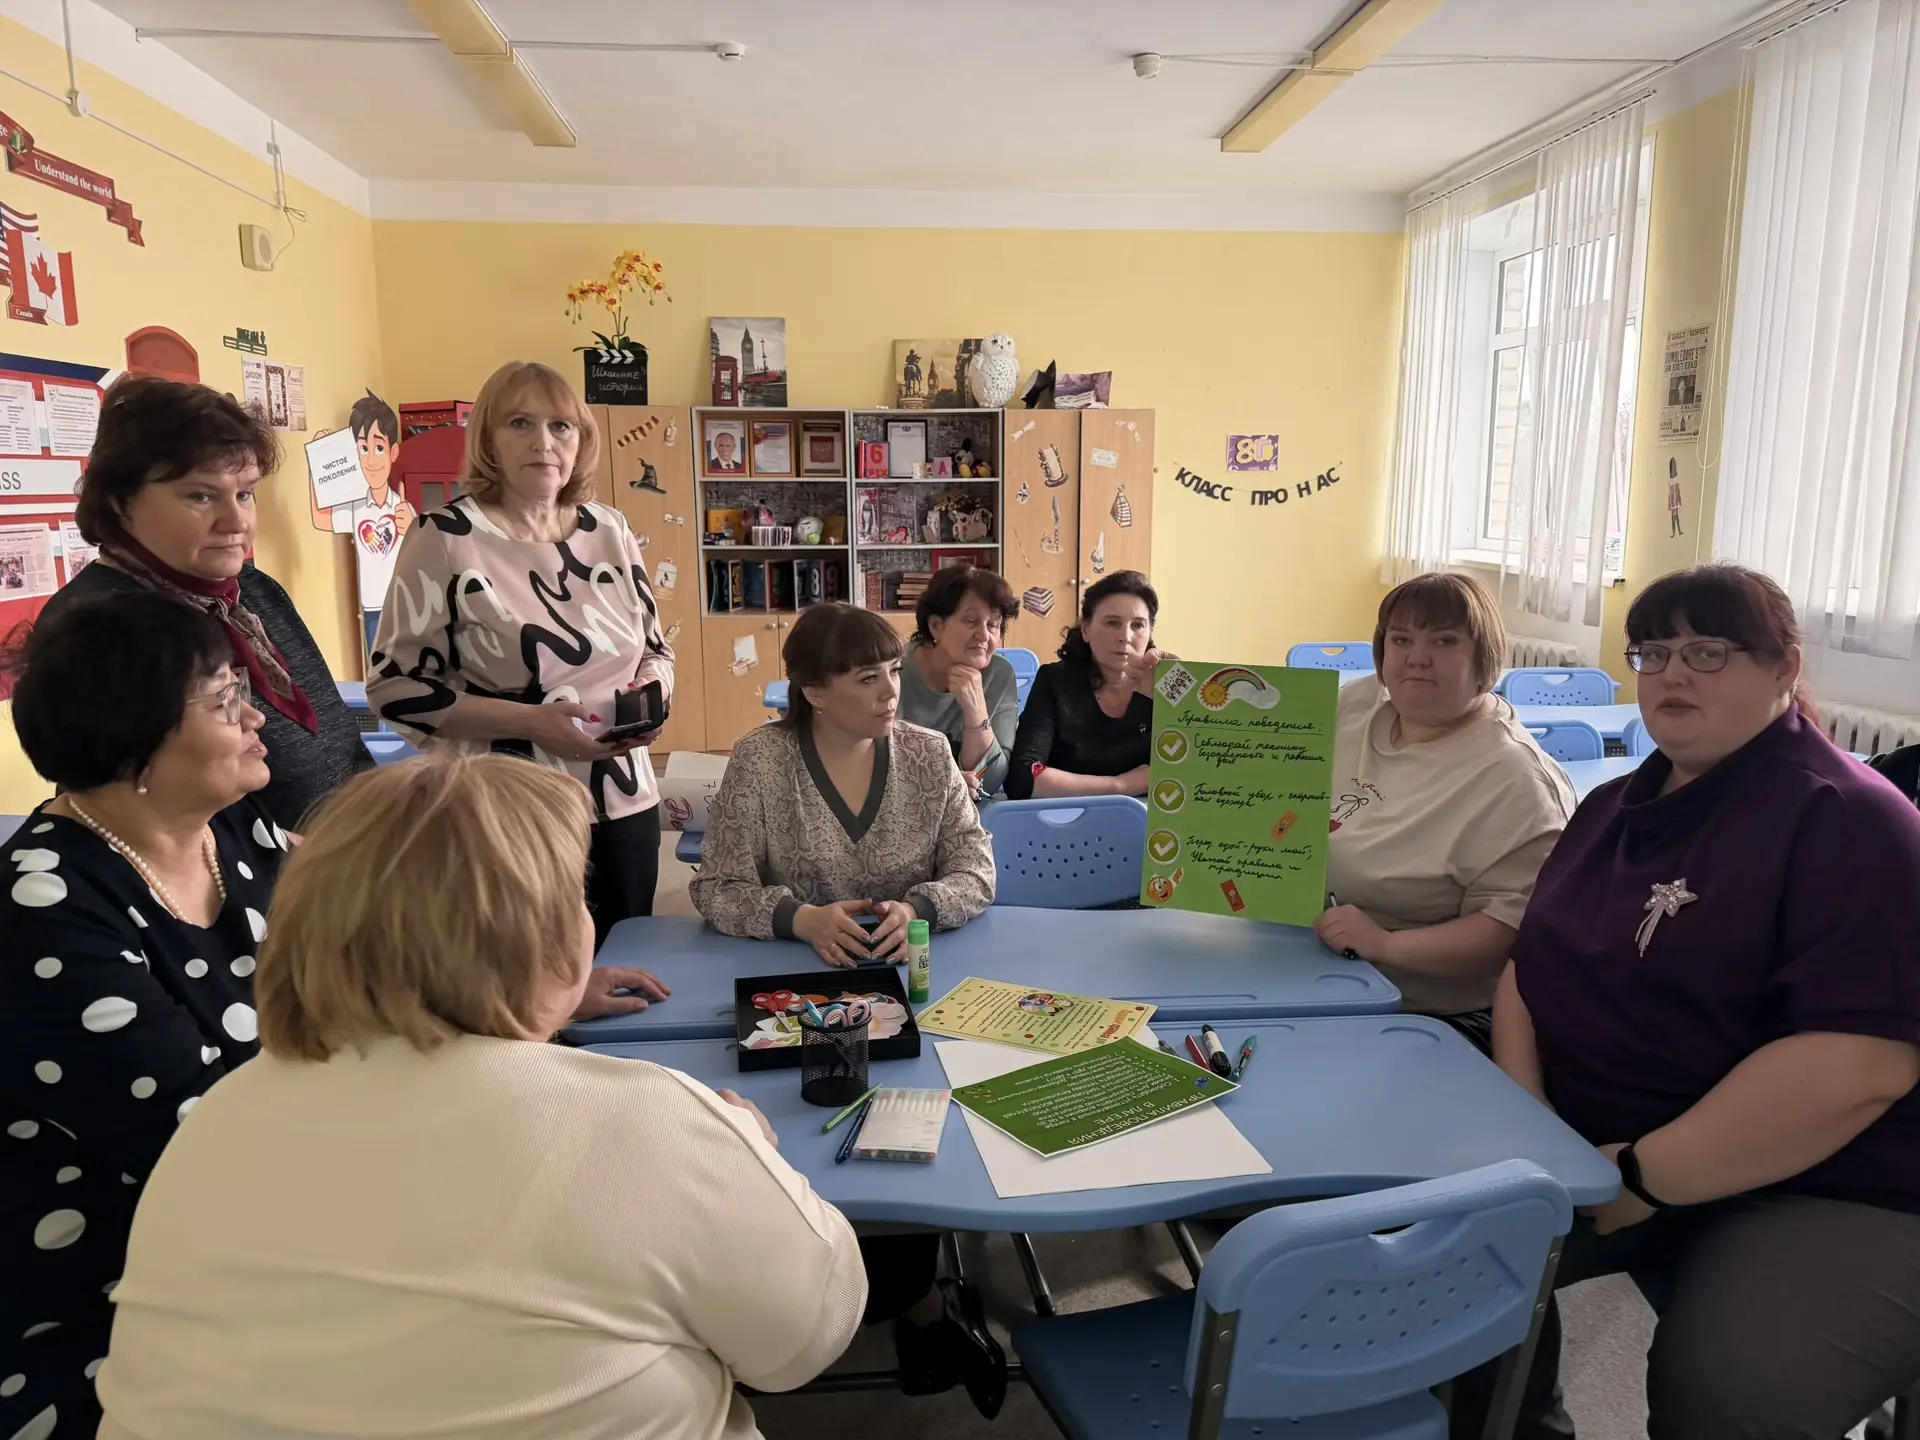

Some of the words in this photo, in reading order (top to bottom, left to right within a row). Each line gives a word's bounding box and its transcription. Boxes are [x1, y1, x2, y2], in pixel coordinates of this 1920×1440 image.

[34, 159, 79, 187] Understand
[79, 178, 92, 191] the
[92, 185, 113, 199] world
[15, 309, 33, 318] Canada
[322, 456, 349, 471] ЧИСТОЕ
[870, 444, 883, 464] 6
[318, 464, 358, 485] ПОКОЛЕНИЕ
[1174, 467, 1234, 502] КЛАСС
[1251, 488, 1289, 506] ПРО
[1178, 710, 1243, 727] Правила
[1194, 733, 1252, 752] Соблюдай
[1256, 742, 1308, 754] технику
[1199, 748, 1264, 762] безопасности
[1282, 750, 1325, 763] режим
[1216, 757, 1236, 768] дня
[1194, 783, 1243, 797] Головной
[1248, 789, 1275, 801] убор
[1216, 799, 1256, 809] одежда
[1186, 836, 1213, 851] Перед
[1190, 850, 1232, 863] Уважай
[1237, 858, 1284, 870] правила
[1130, 1080, 1174, 1099] Соблюдать
[1140, 1100, 1156, 1108] В
[1144, 1091, 1207, 1117] ПРАВИЛА
[1091, 1105, 1145, 1126] ЛАГЕРЕ
[1065, 1113, 1149, 1145] ПОВЕДЕНИЯ
